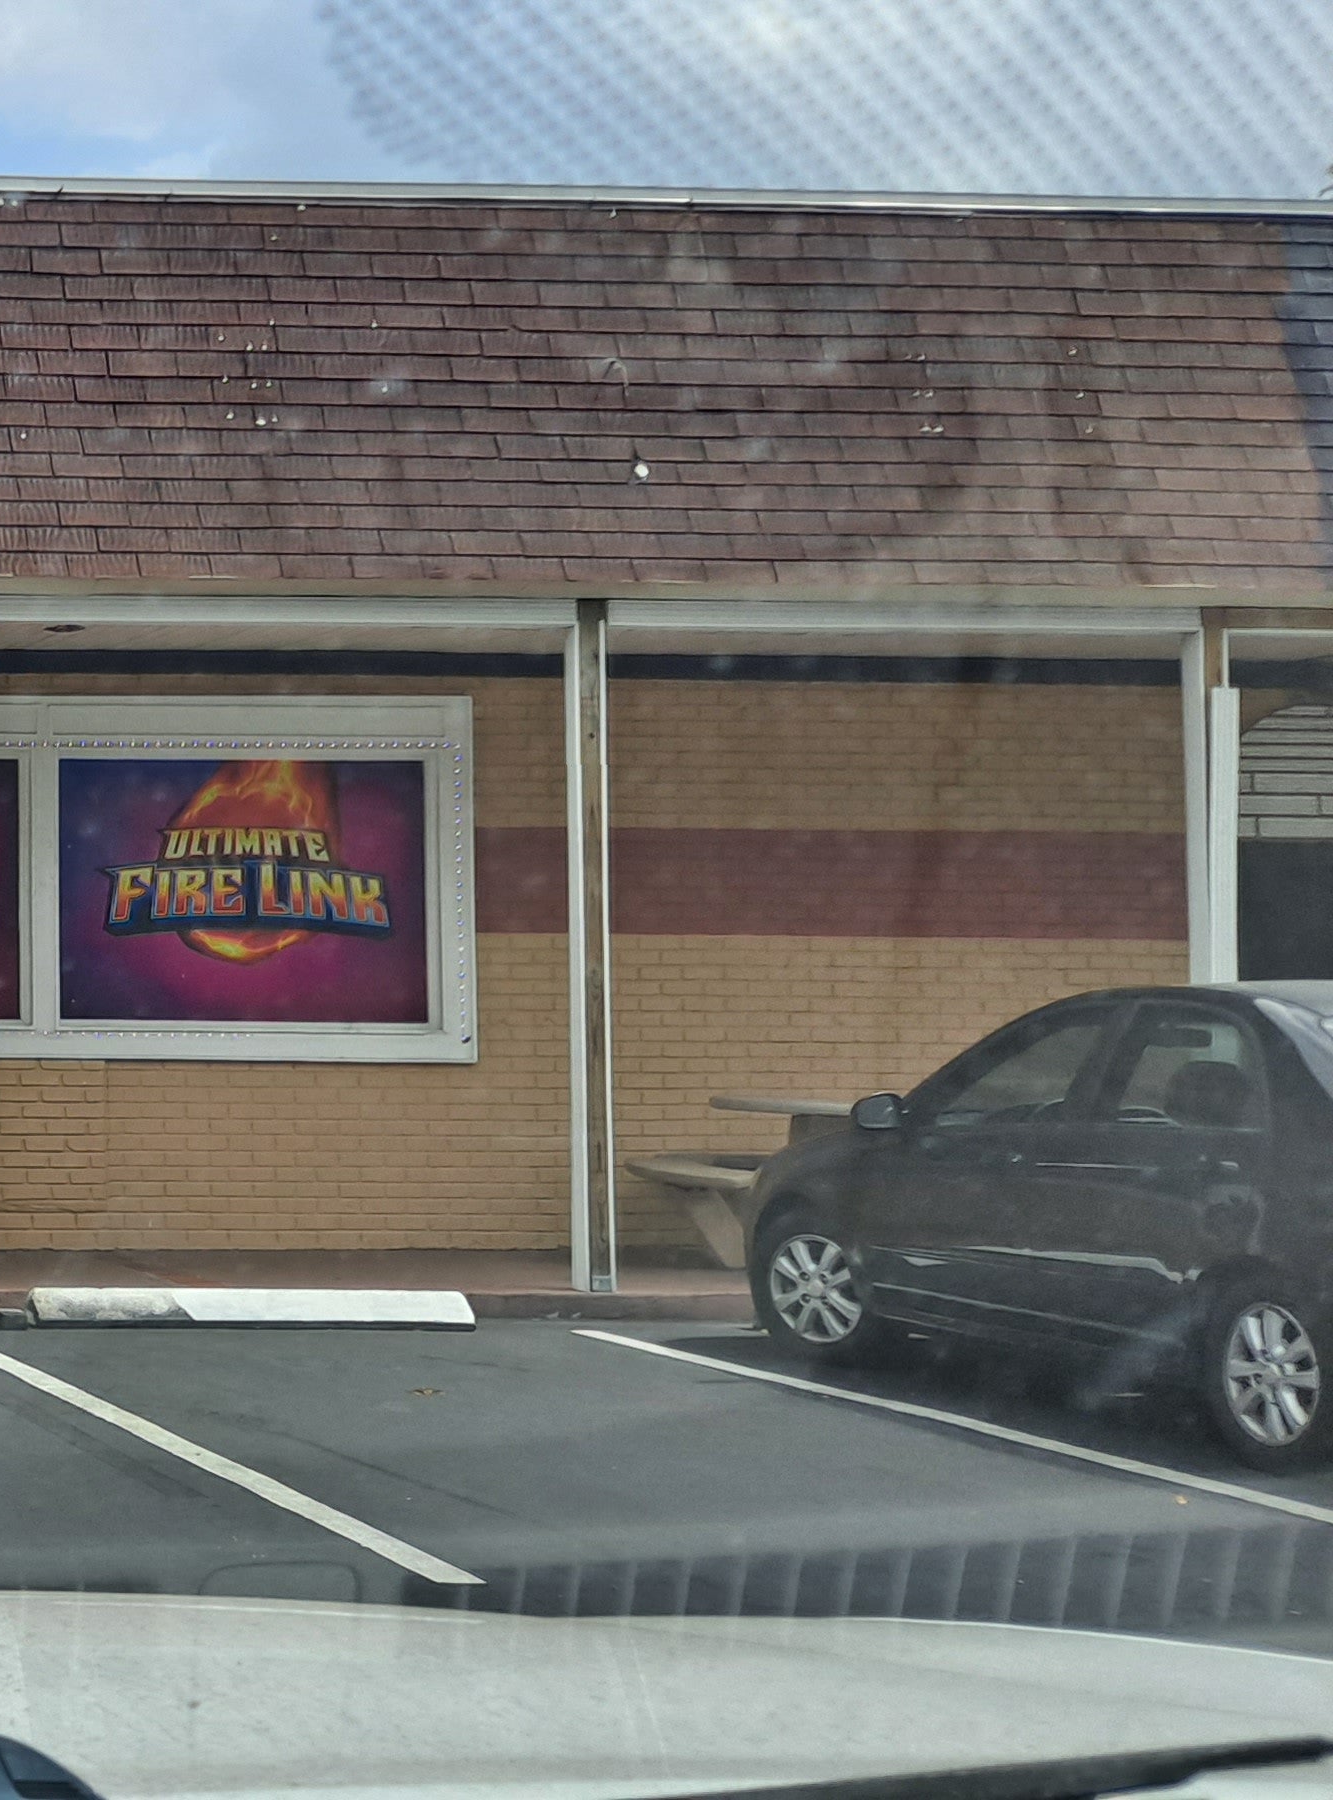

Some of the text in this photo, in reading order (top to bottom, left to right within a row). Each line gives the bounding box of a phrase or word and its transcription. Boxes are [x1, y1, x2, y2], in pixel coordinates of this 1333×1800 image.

[164, 829, 330, 862] ULTIMATE
[110, 860, 390, 928] FIRE LINK
